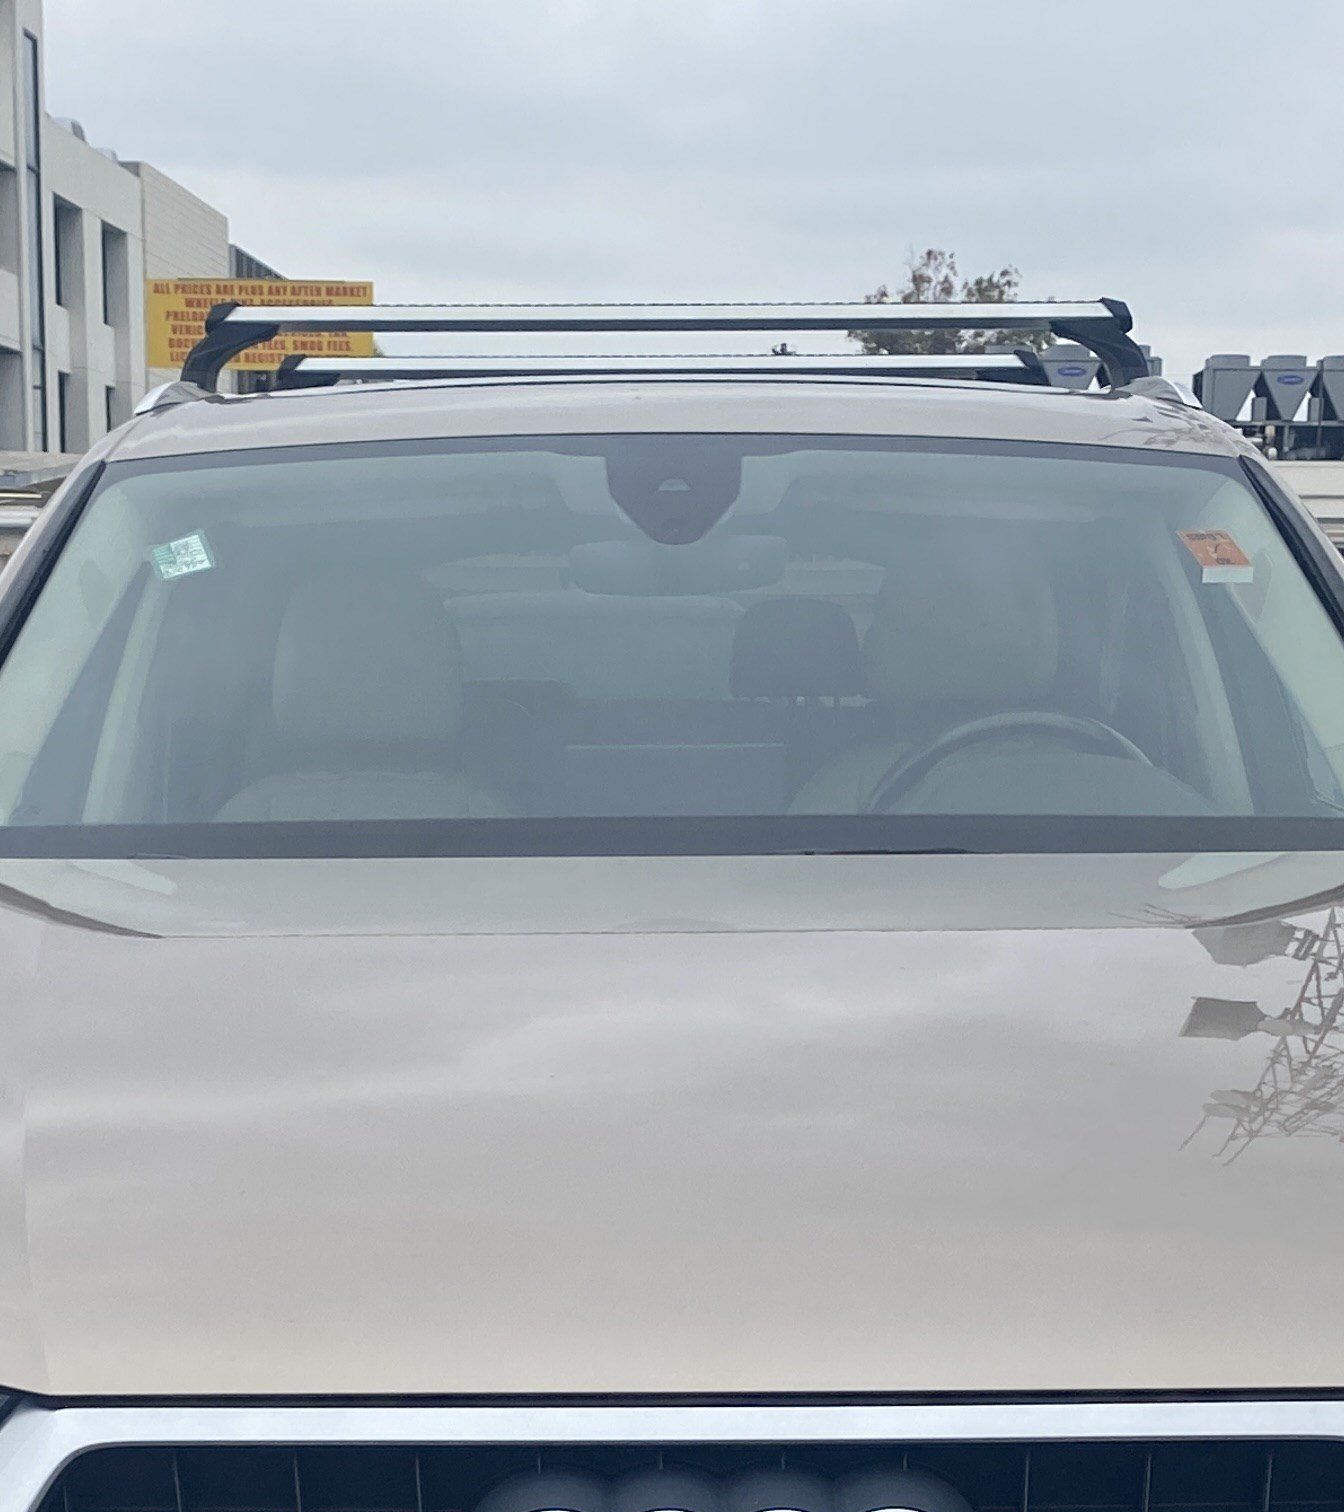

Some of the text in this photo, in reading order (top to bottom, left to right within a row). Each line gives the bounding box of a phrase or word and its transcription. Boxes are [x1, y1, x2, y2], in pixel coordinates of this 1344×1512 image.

[153, 283, 367, 297] ALL PRICES ARE PLUS ANY AFTER MARKET
